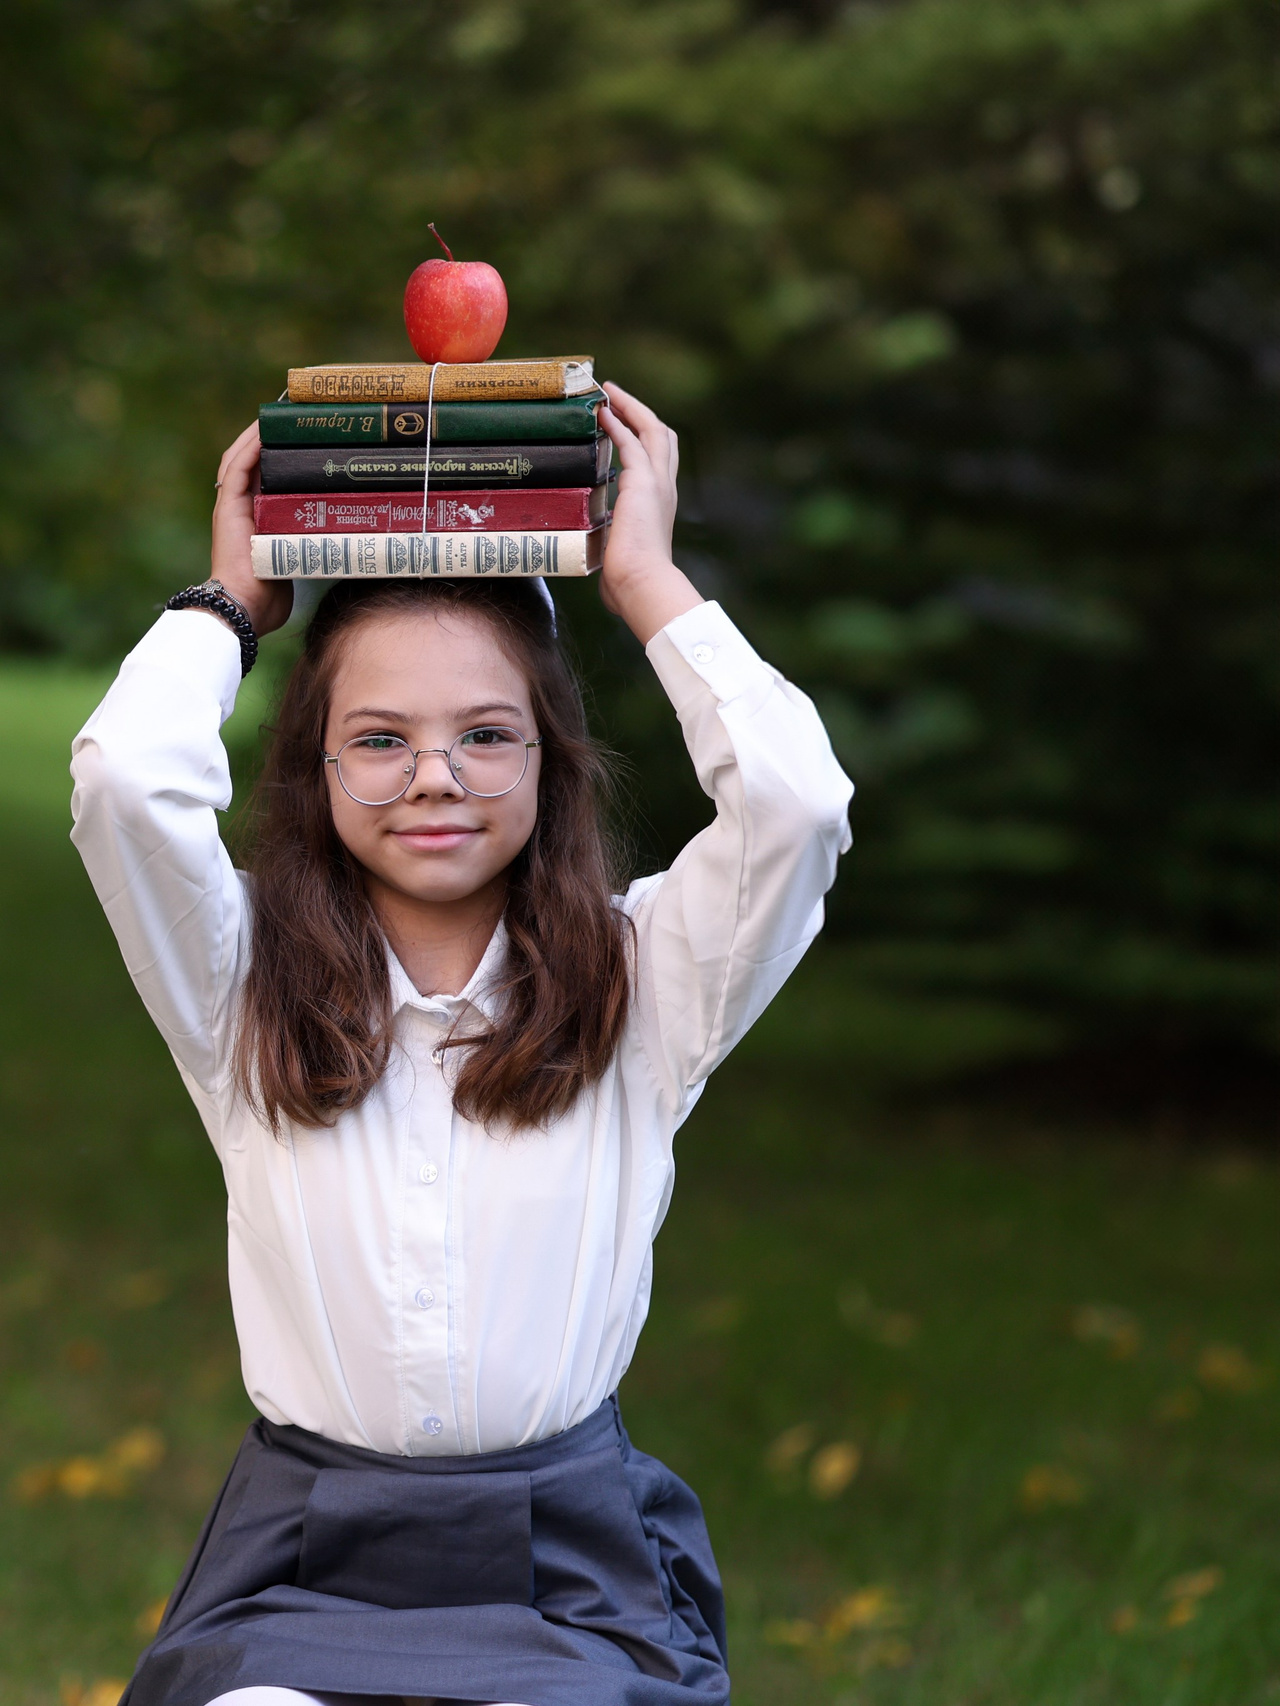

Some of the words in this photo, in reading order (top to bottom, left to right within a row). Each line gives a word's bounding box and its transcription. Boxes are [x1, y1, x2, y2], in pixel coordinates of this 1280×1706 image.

[311, 374, 406, 397] ДЕТСТВО
[296, 413, 356, 432] Гаршин
[359, 416, 375, 432] В.
[350, 462, 397, 473] сказки
[400, 458, 467, 472] народные
[470, 458, 518, 475] Русские
[336, 515, 379, 527] Графиня
[364, 537, 378, 574] БЛОК
[445, 537, 453, 572] ЛИРИКА
[460, 542, 468, 568] ТЕАТР
